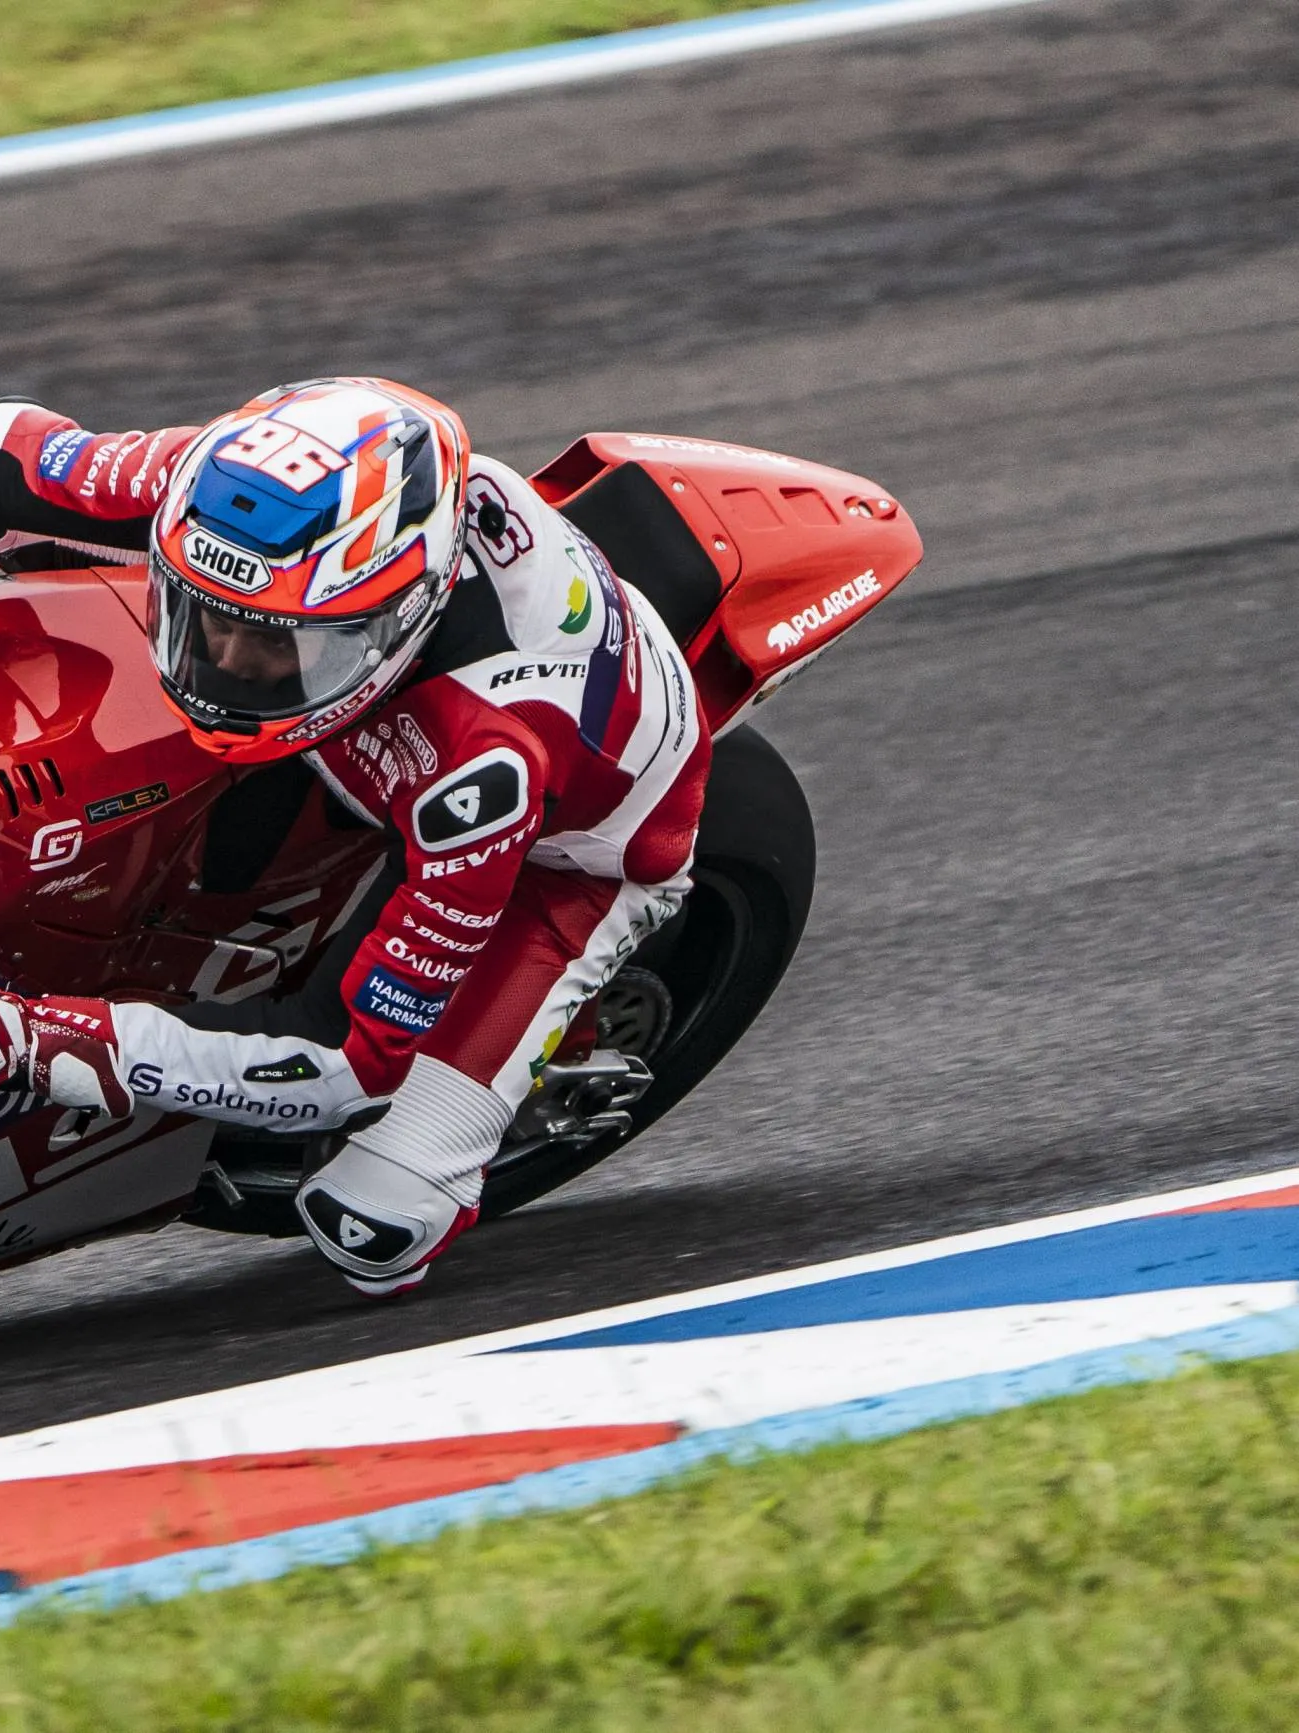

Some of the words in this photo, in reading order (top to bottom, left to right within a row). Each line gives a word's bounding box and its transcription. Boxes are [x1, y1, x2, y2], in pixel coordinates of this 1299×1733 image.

[213, 417, 353, 494] 96
[190, 537, 258, 586] SHOEI
[154, 554, 180, 585] TRADE
[181, 582, 240, 616] WATCHES
[244, 609, 265, 623] UK
[269, 616, 298, 627] LTD
[792, 569, 882, 639] POLARCUBE
[402, 719, 435, 770] SHOEI
[89, 785, 166, 822] KALEX
[415, 925, 488, 952] DUNLO
[402, 953, 473, 982] Aiuke
[369, 976, 446, 1013] HAMILTON
[370, 996, 436, 1028] TARMAC
[173, 1082, 320, 1120] solunion
